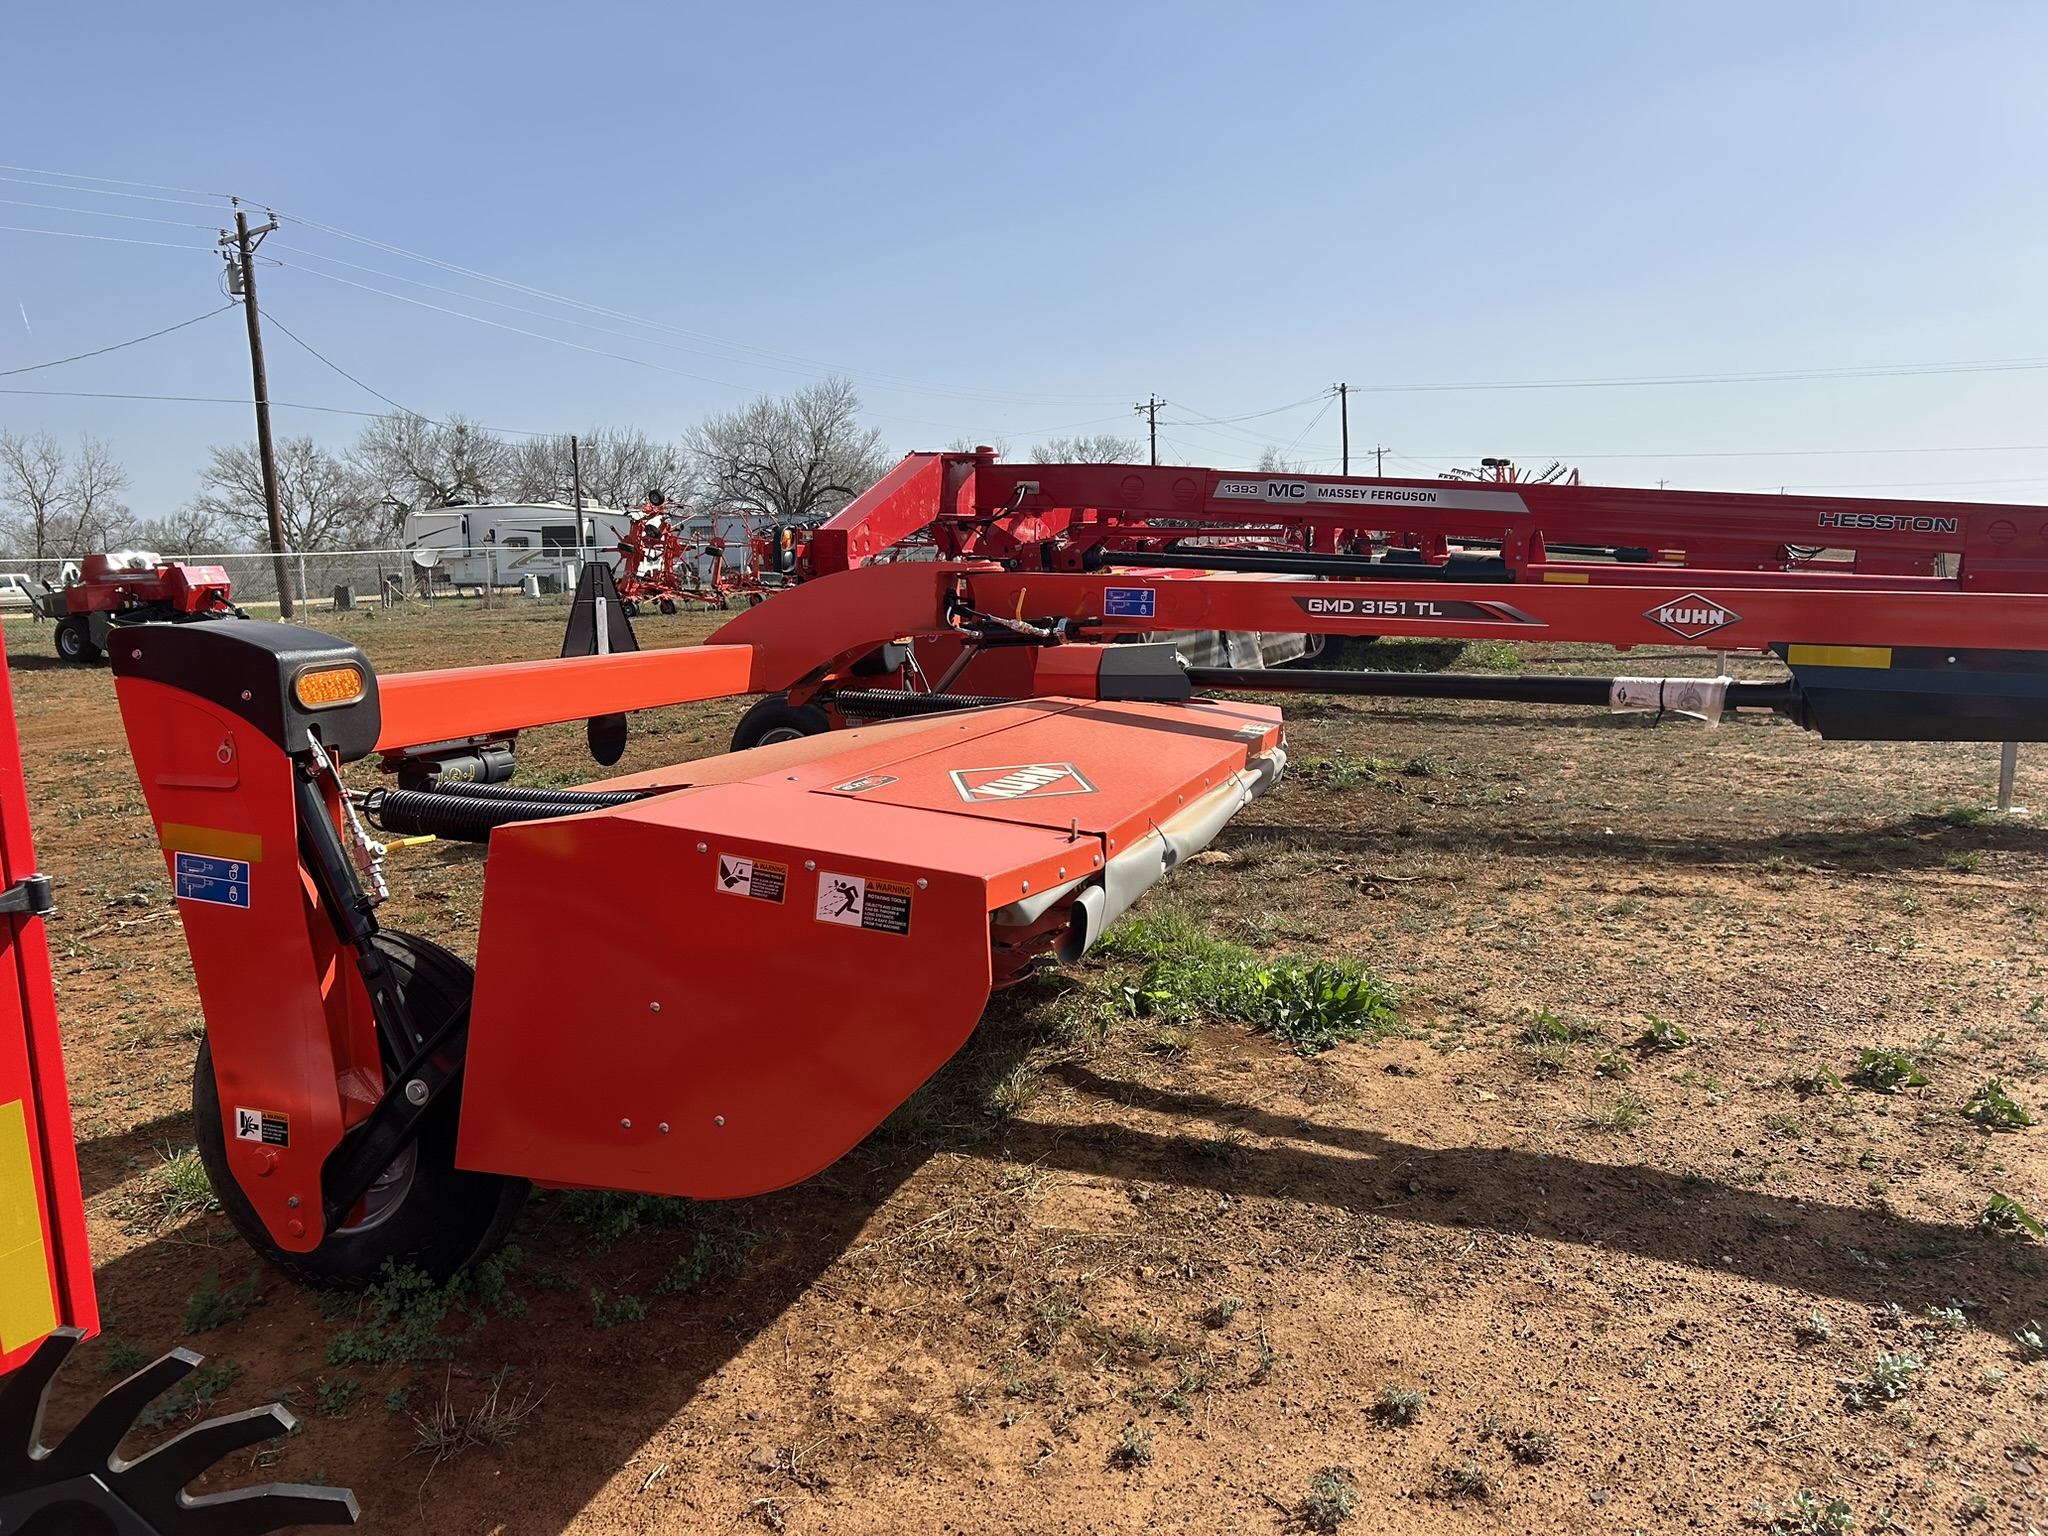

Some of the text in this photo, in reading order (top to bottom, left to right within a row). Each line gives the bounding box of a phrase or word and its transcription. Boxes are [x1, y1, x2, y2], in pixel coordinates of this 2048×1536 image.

[1224, 483, 1437, 502] 1393 MC MASSEY FERGUSON
[1818, 512, 1958, 533] HESSTON
[1308, 599, 1443, 616] GMD 3151 TL
[1660, 608, 1725, 625] KUHN
[968, 766, 1073, 798] KUHN
[759, 863, 786, 873] WARNING
[875, 882, 911, 895] WARNING
